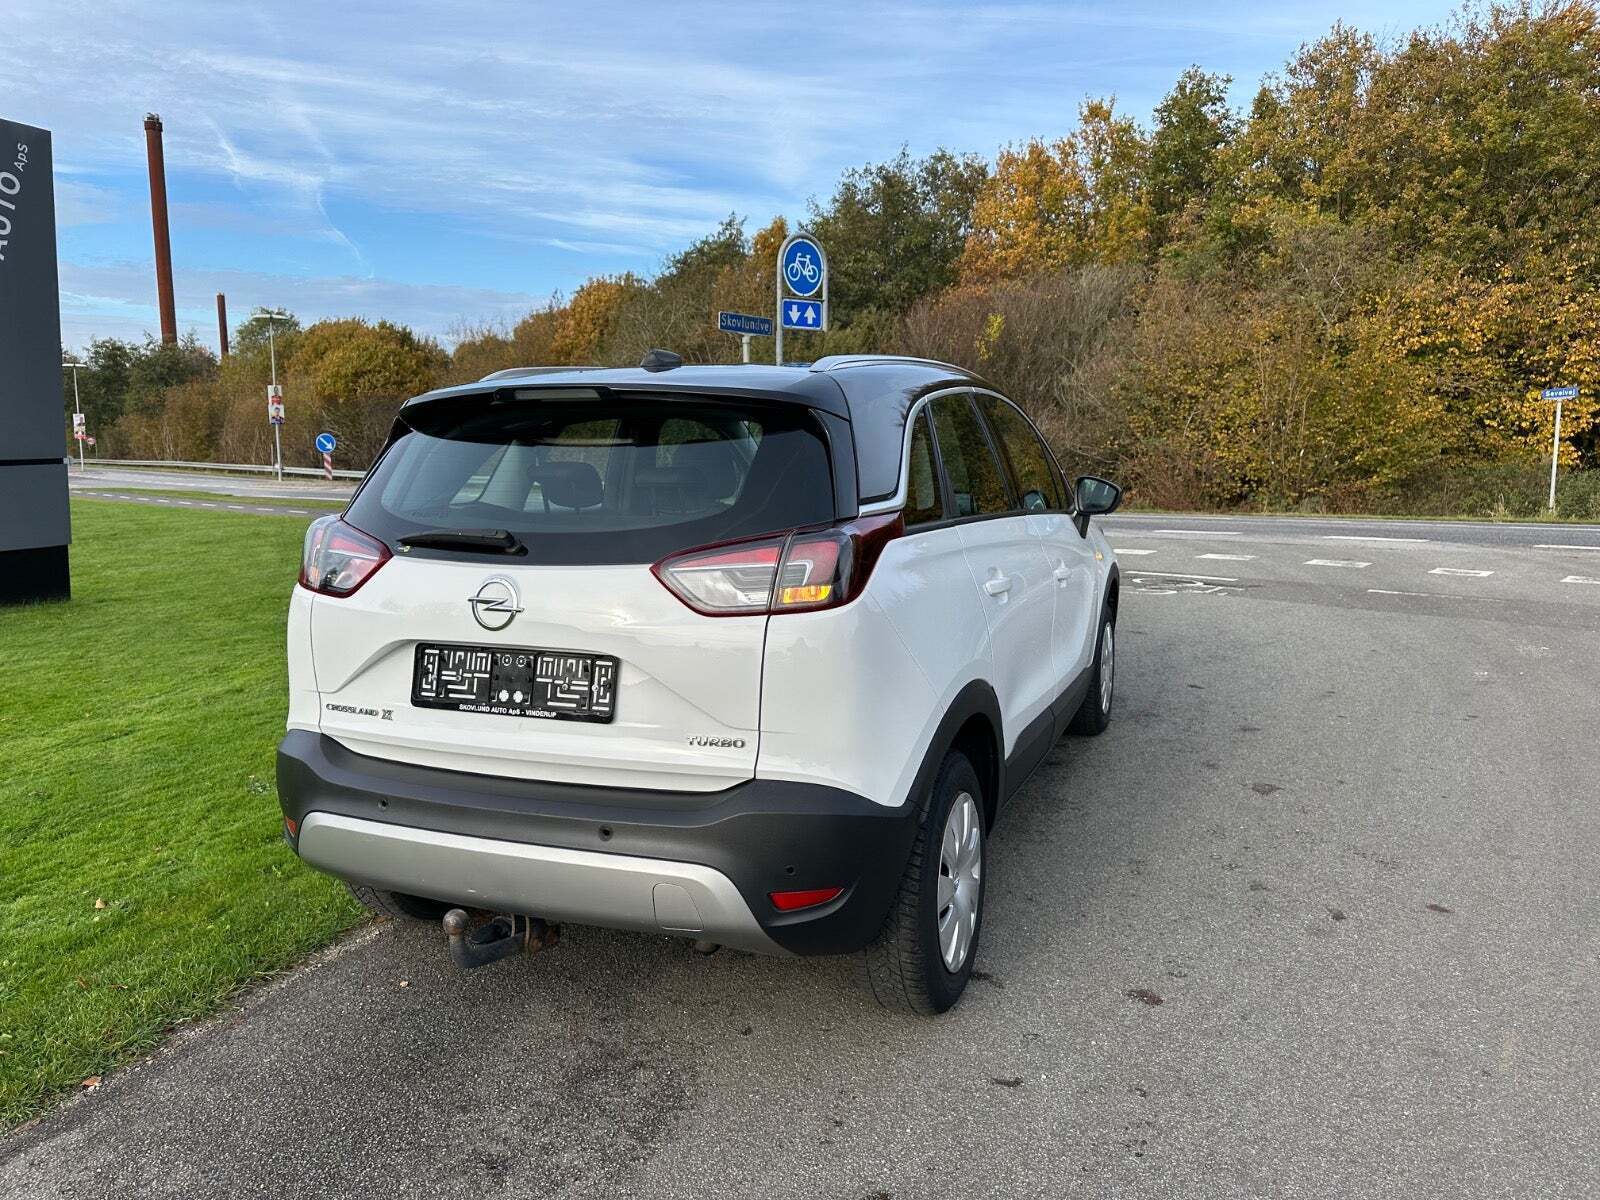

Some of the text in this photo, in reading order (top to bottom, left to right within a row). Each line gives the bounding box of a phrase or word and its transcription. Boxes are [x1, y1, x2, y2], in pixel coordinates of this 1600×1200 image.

[14, 142, 28, 172] ApS
[326, 703, 379, 717] CROSSLAND
[459, 703, 490, 713] SKOVLUND
[490, 706, 508, 714] AUTO
[508, 707, 521, 716] ApS
[525, 709, 557, 718] VINDERUP
[687, 736, 746, 748] TURBO
